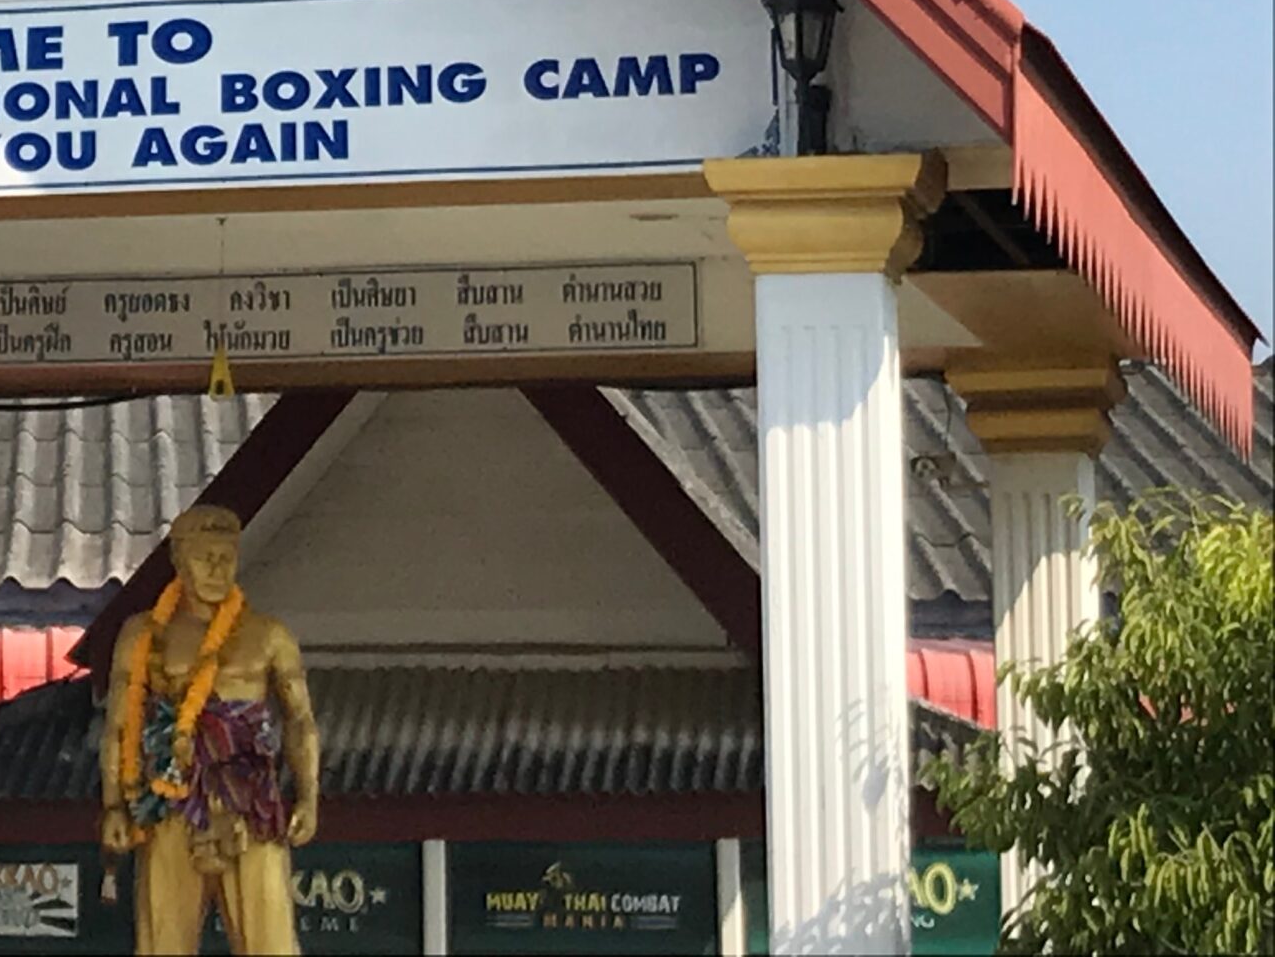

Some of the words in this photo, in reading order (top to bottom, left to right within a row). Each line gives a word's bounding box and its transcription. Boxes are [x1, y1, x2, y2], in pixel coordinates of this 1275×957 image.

[107, 17, 213, 67] TO
[221, 61, 487, 113] BOXING
[523, 53, 720, 100] CAMP
[131, 119, 349, 168] AGAIN
[485, 891, 540, 911] MUAY
[565, 892, 606, 912] THAI
[610, 893, 681, 913] COMBAT
[542, 913, 624, 929] MANIA
